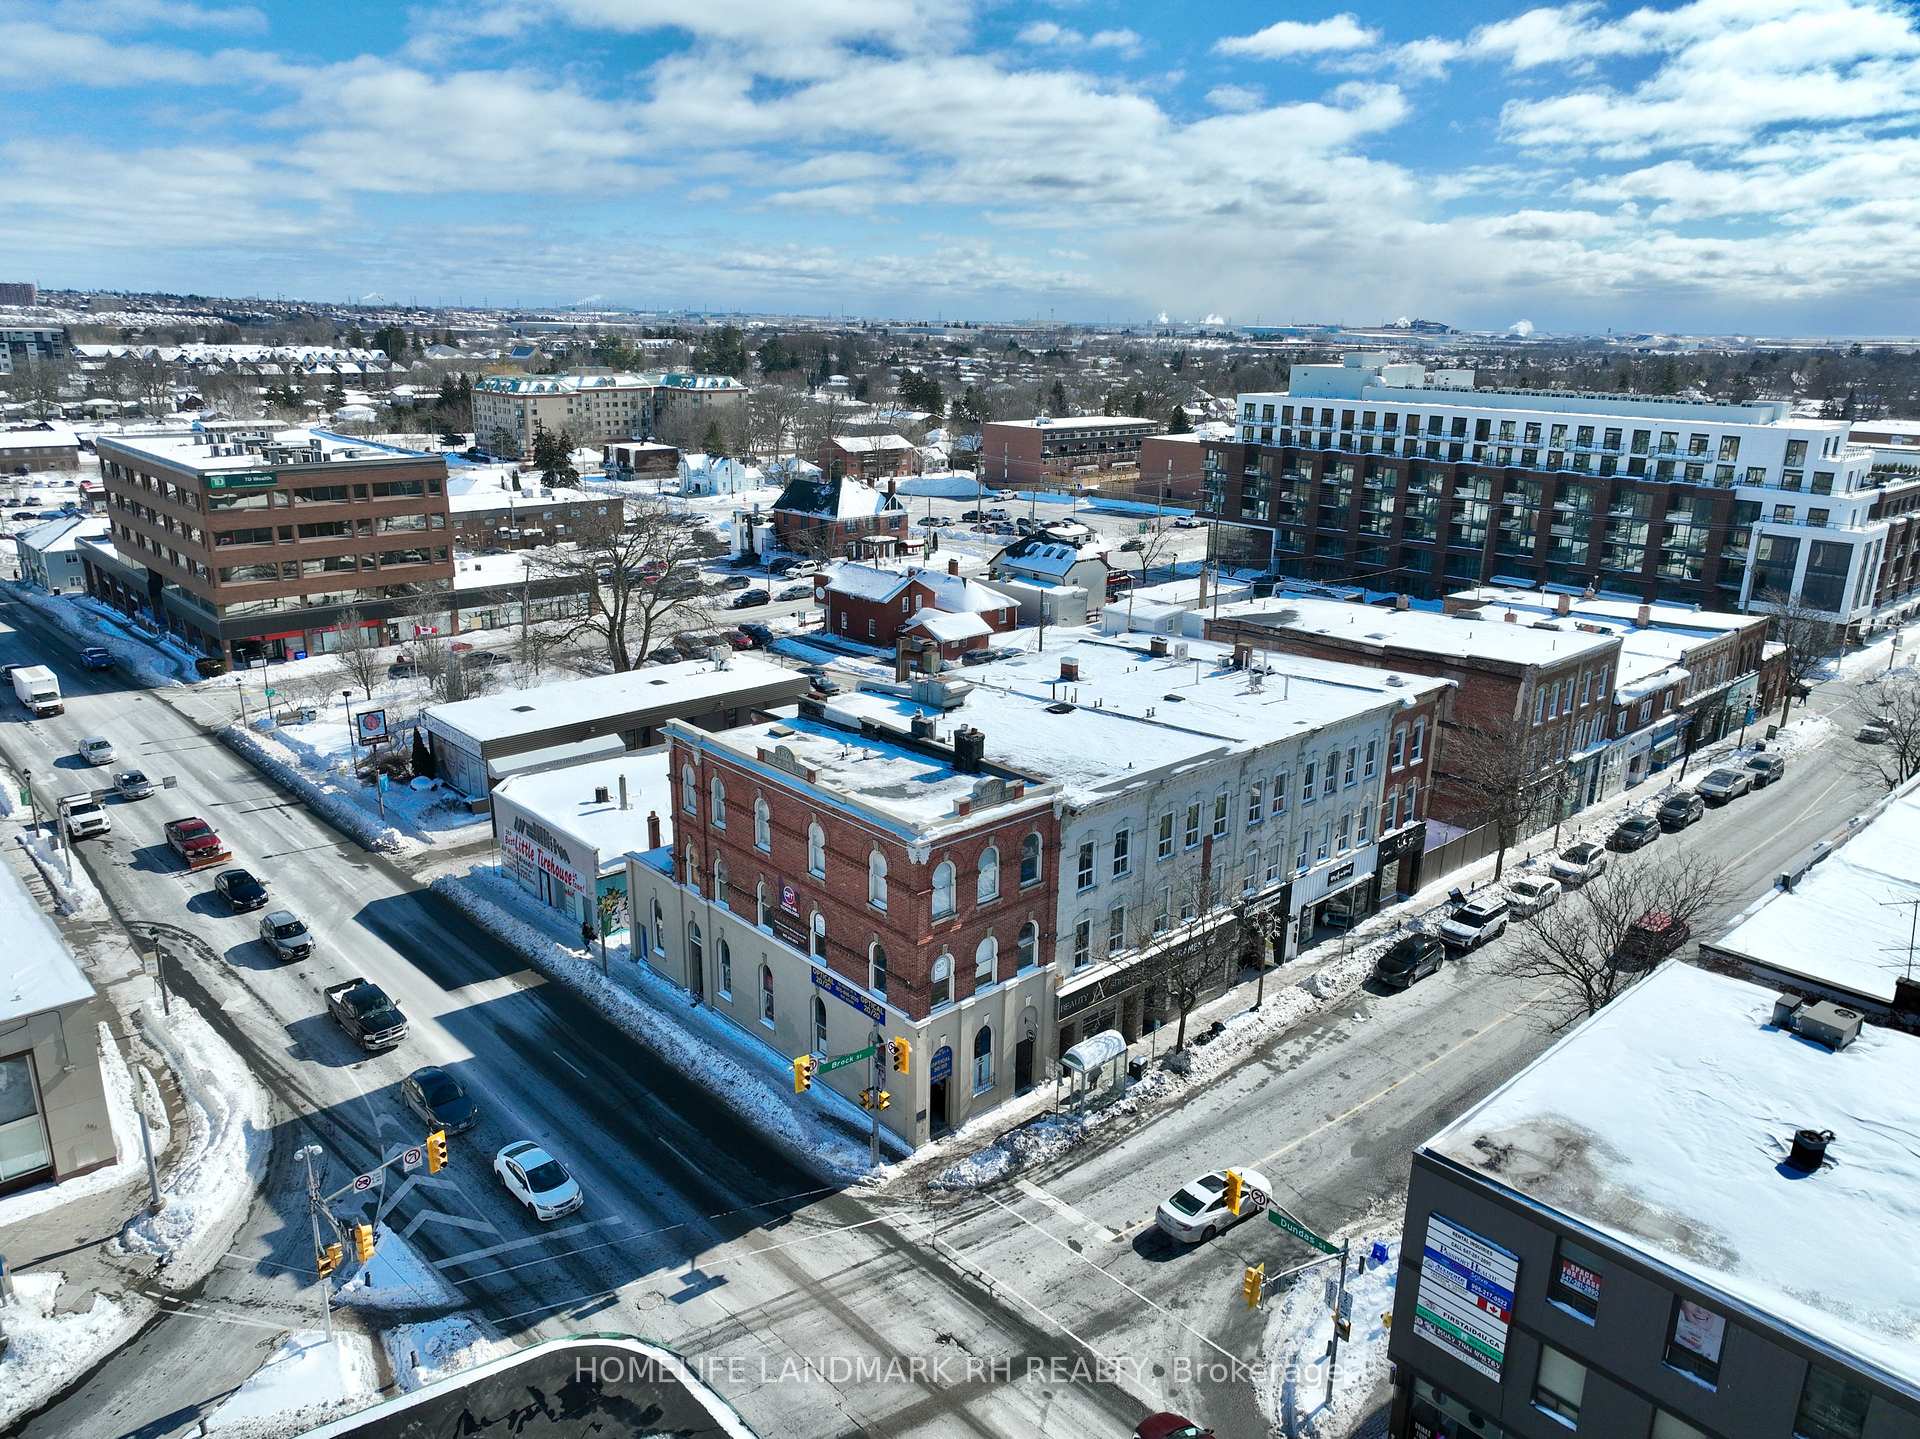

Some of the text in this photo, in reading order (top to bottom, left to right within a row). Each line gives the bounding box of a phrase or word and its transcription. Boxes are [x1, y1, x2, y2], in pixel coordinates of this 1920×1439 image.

[515, 835, 534, 862] Little
[812, 967, 835, 985] OPTICAL
[861, 995, 884, 1015] OPTICAL
[864, 1006, 880, 1020] 20/20
[832, 1056, 854, 1069] Brock
[1280, 1218, 1315, 1244] Dundas
[1451, 1241, 1462, 1251] CALL
[1452, 1231, 1493, 1257] RENTAL INQUIRIES
[1440, 1245, 1470, 1267] PASSPORT
[1471, 1262, 1497, 1282] HEALTH
[1571, 1264, 1593, 1281] SPACE
[1563, 1267, 1600, 1291] FOR LEASE
[1443, 1312, 1500, 1349] FIRSTAID4U.CA
